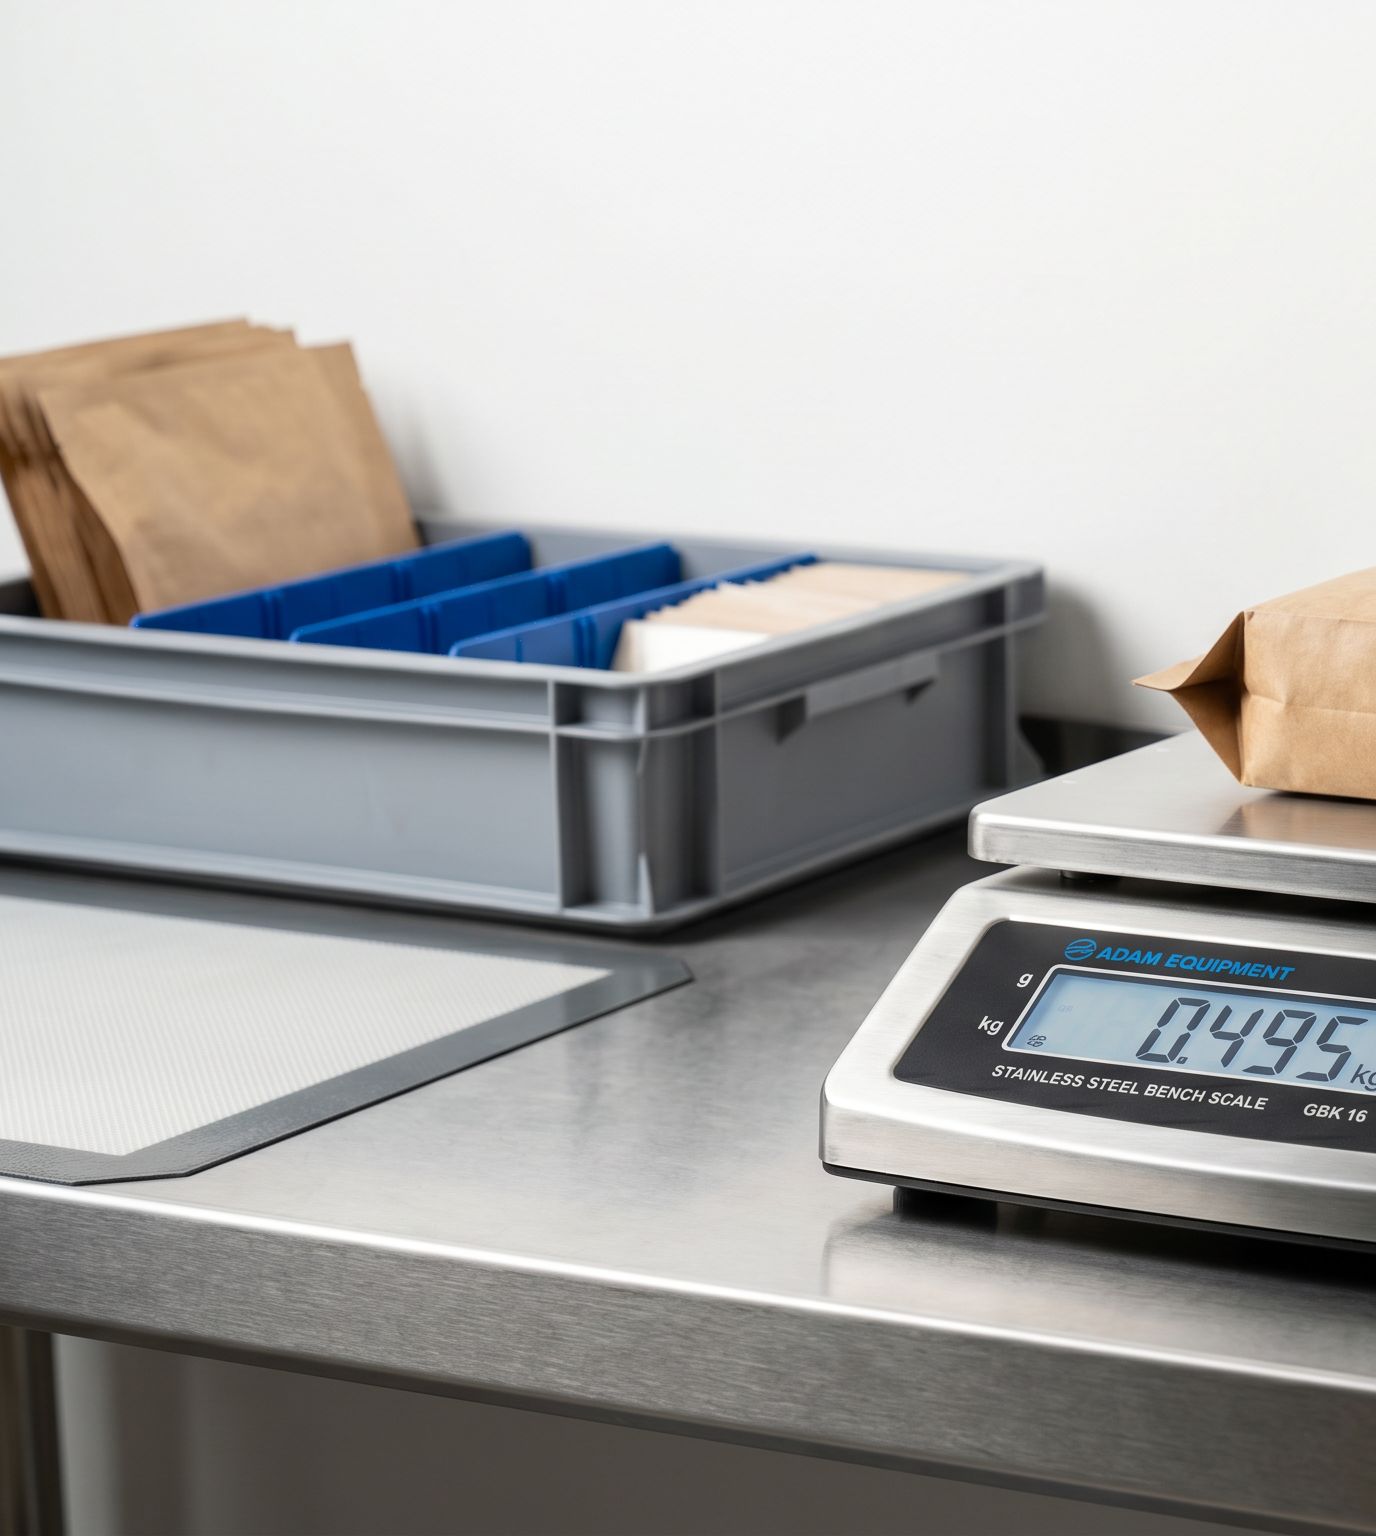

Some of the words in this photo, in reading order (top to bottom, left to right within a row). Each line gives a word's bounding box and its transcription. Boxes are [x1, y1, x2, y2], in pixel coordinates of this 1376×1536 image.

[1096, 946, 1164, 967] ADAM
[1164, 953, 1296, 982] EQUIPMENT
[1016, 972, 1034, 988] g
[977, 1015, 1004, 1036] kg
[1136, 997, 1369, 1082] 0.495
[991, 1064, 1086, 1088] STAINLESS
[1086, 1077, 1140, 1096] STEEL
[1143, 1083, 1207, 1103] BENCH
[1208, 1091, 1269, 1111] SCALE
[1302, 1103, 1346, 1121] GBK
[1347, 1107, 1369, 1123] 16
